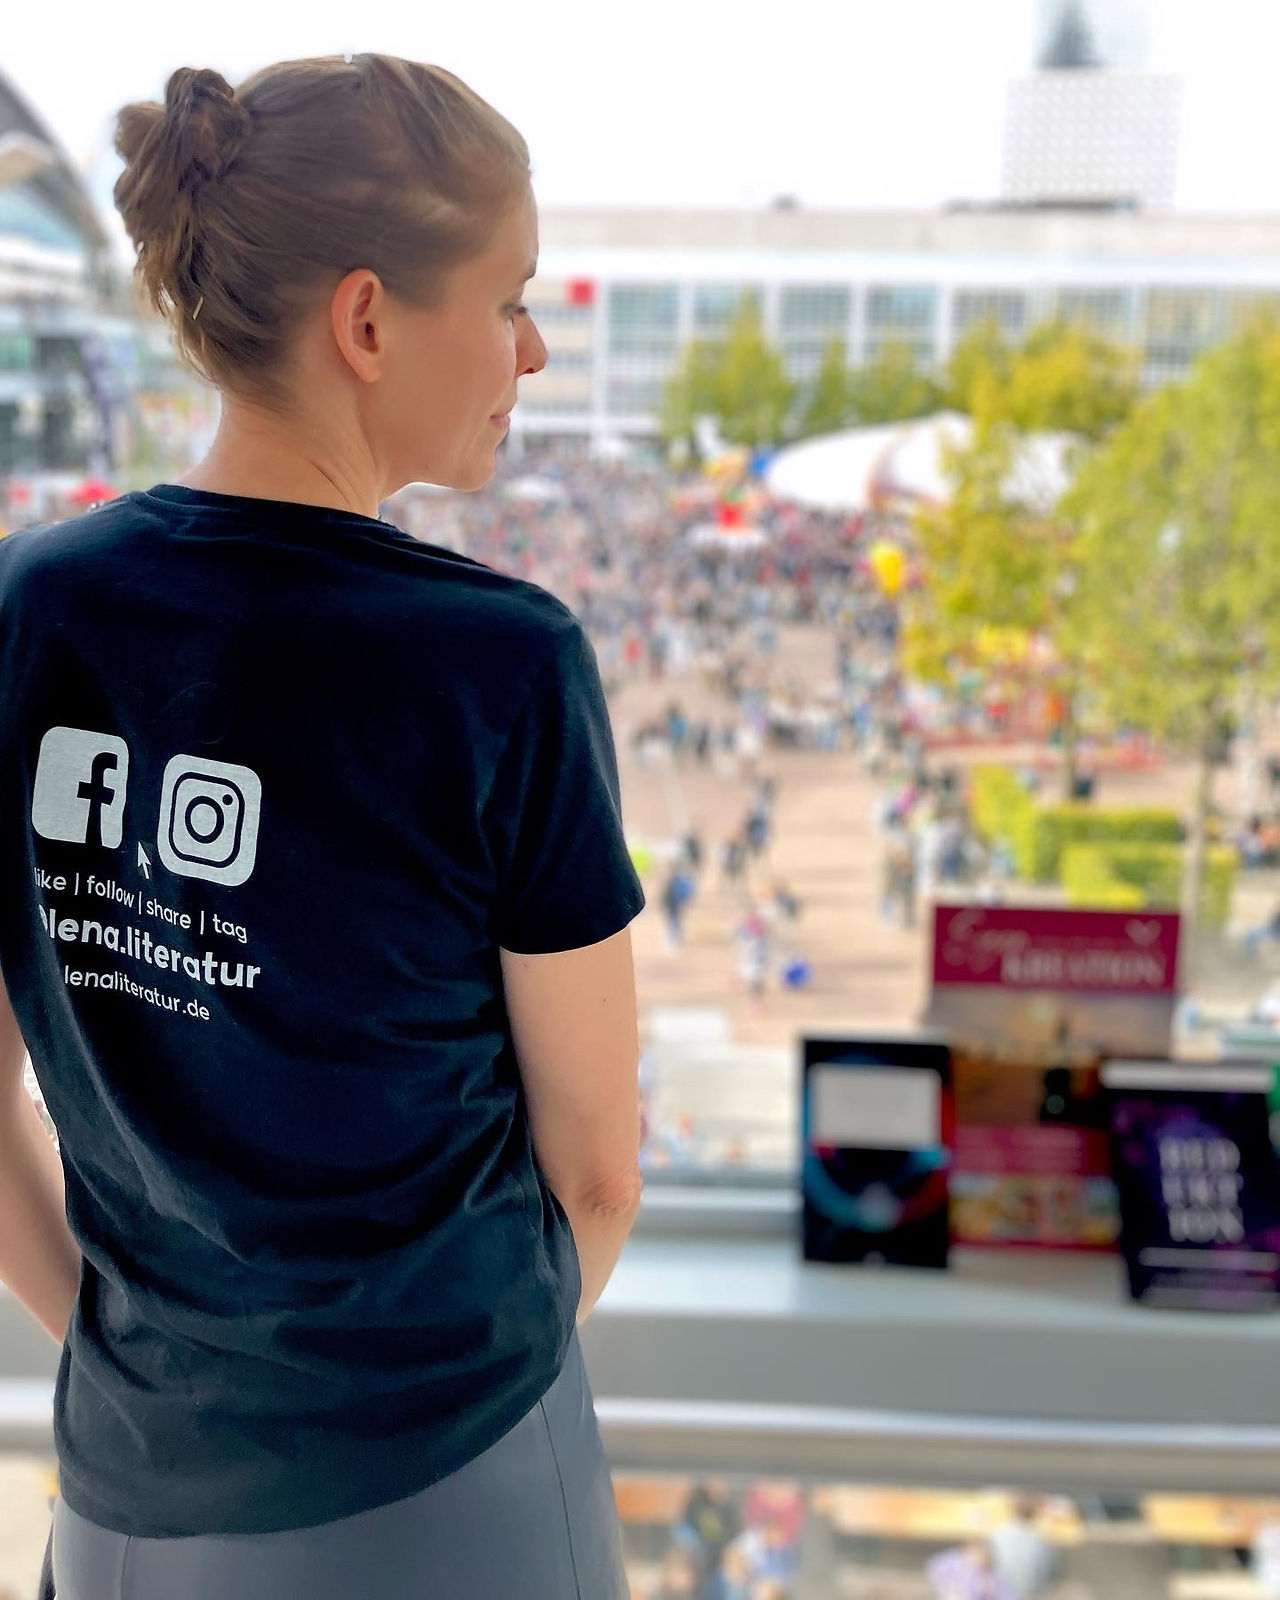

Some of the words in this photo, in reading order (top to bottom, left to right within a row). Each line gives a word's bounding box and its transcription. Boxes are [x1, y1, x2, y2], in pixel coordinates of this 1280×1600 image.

[33, 866, 67, 891] like
[86, 874, 135, 908] follow
[145, 898, 192, 929] share
[212, 913, 248, 944] tag
[64, 964, 210, 1020] lenaliteratur.de
